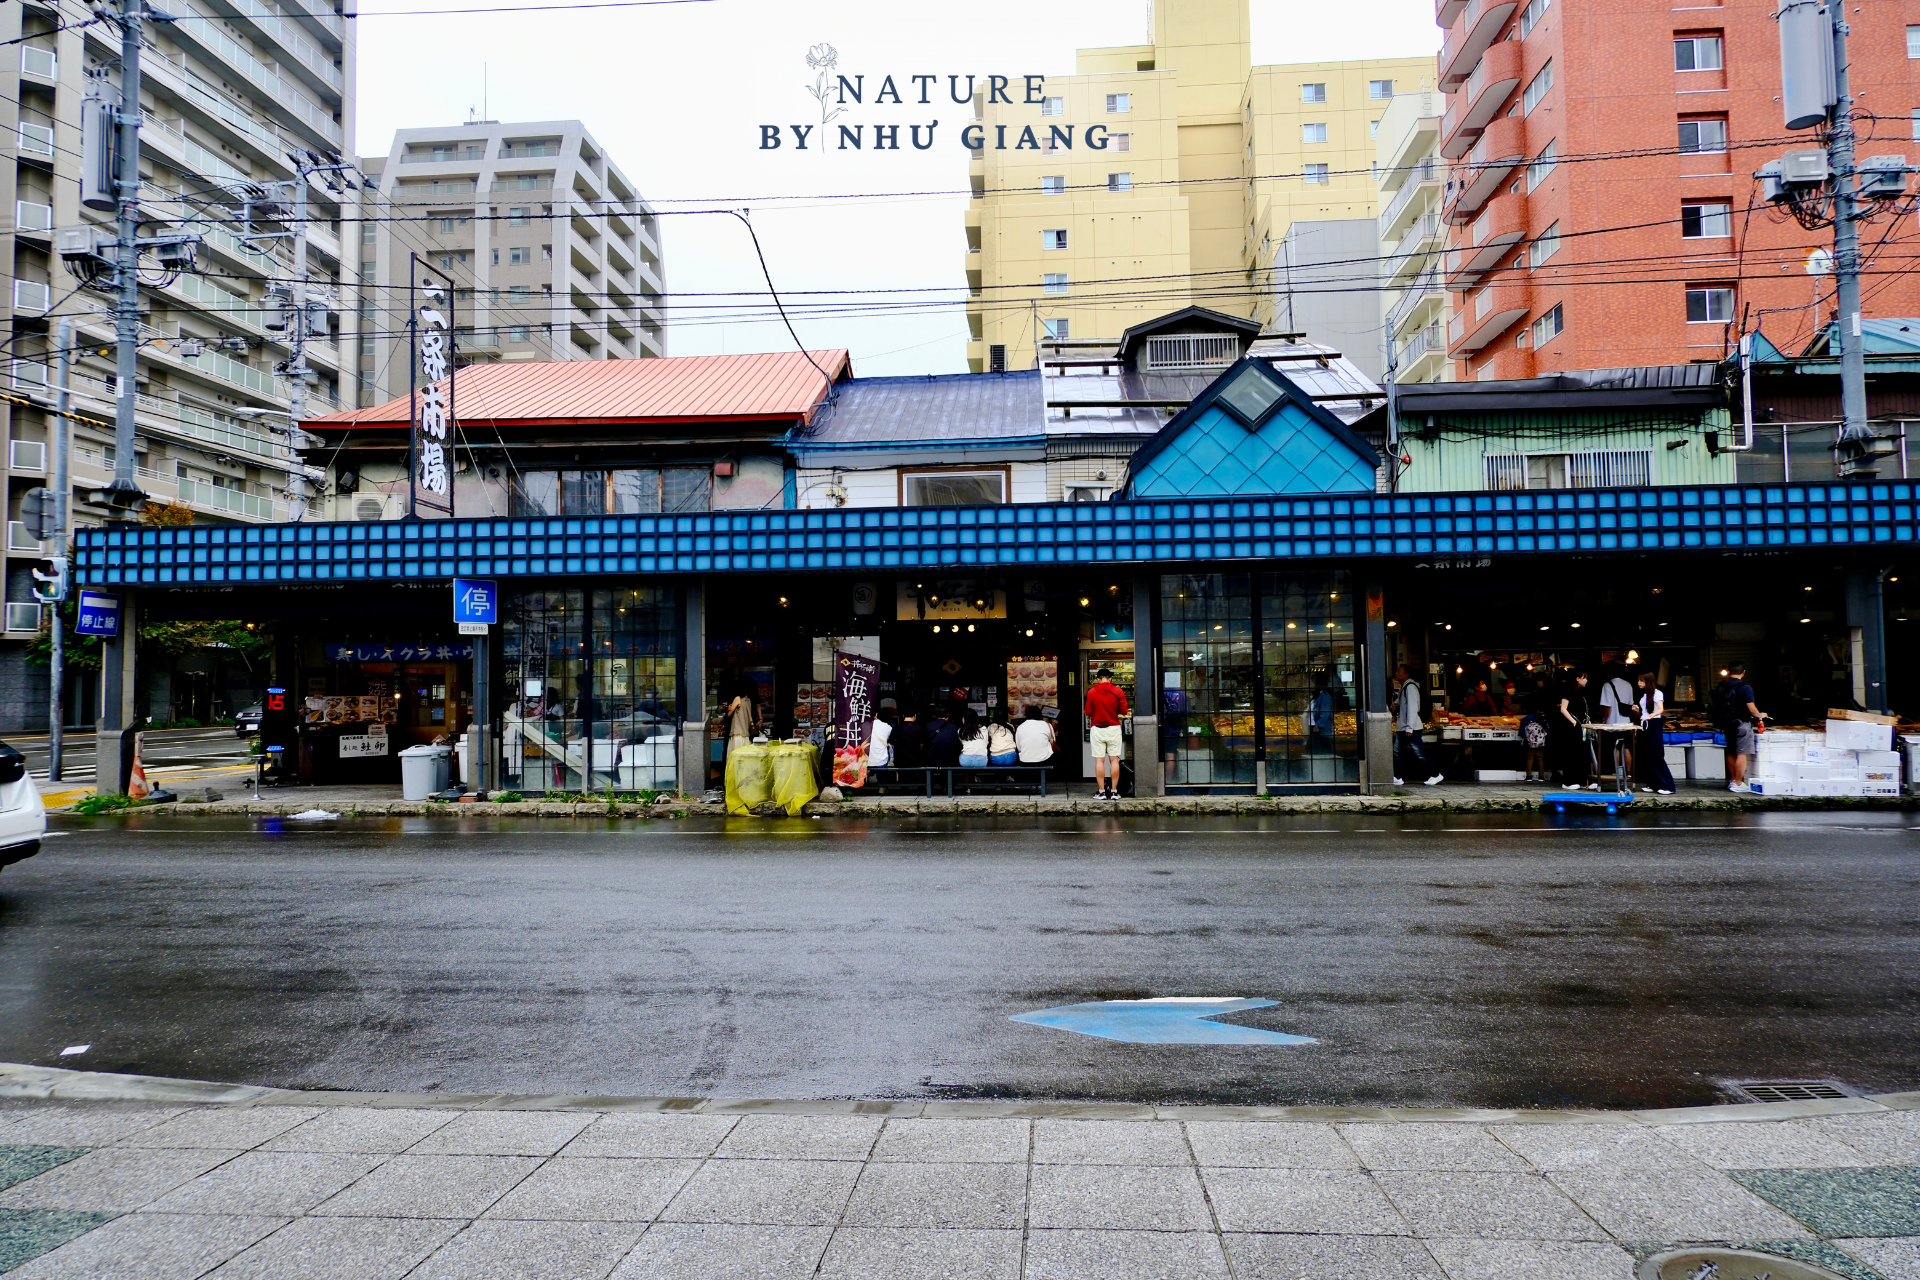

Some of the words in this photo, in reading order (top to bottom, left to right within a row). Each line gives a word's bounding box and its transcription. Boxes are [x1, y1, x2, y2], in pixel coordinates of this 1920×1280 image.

[461, 587, 490, 616] 停
[81, 614, 115, 629] 停止線
[838, 669, 872, 750] 海鮮丼
